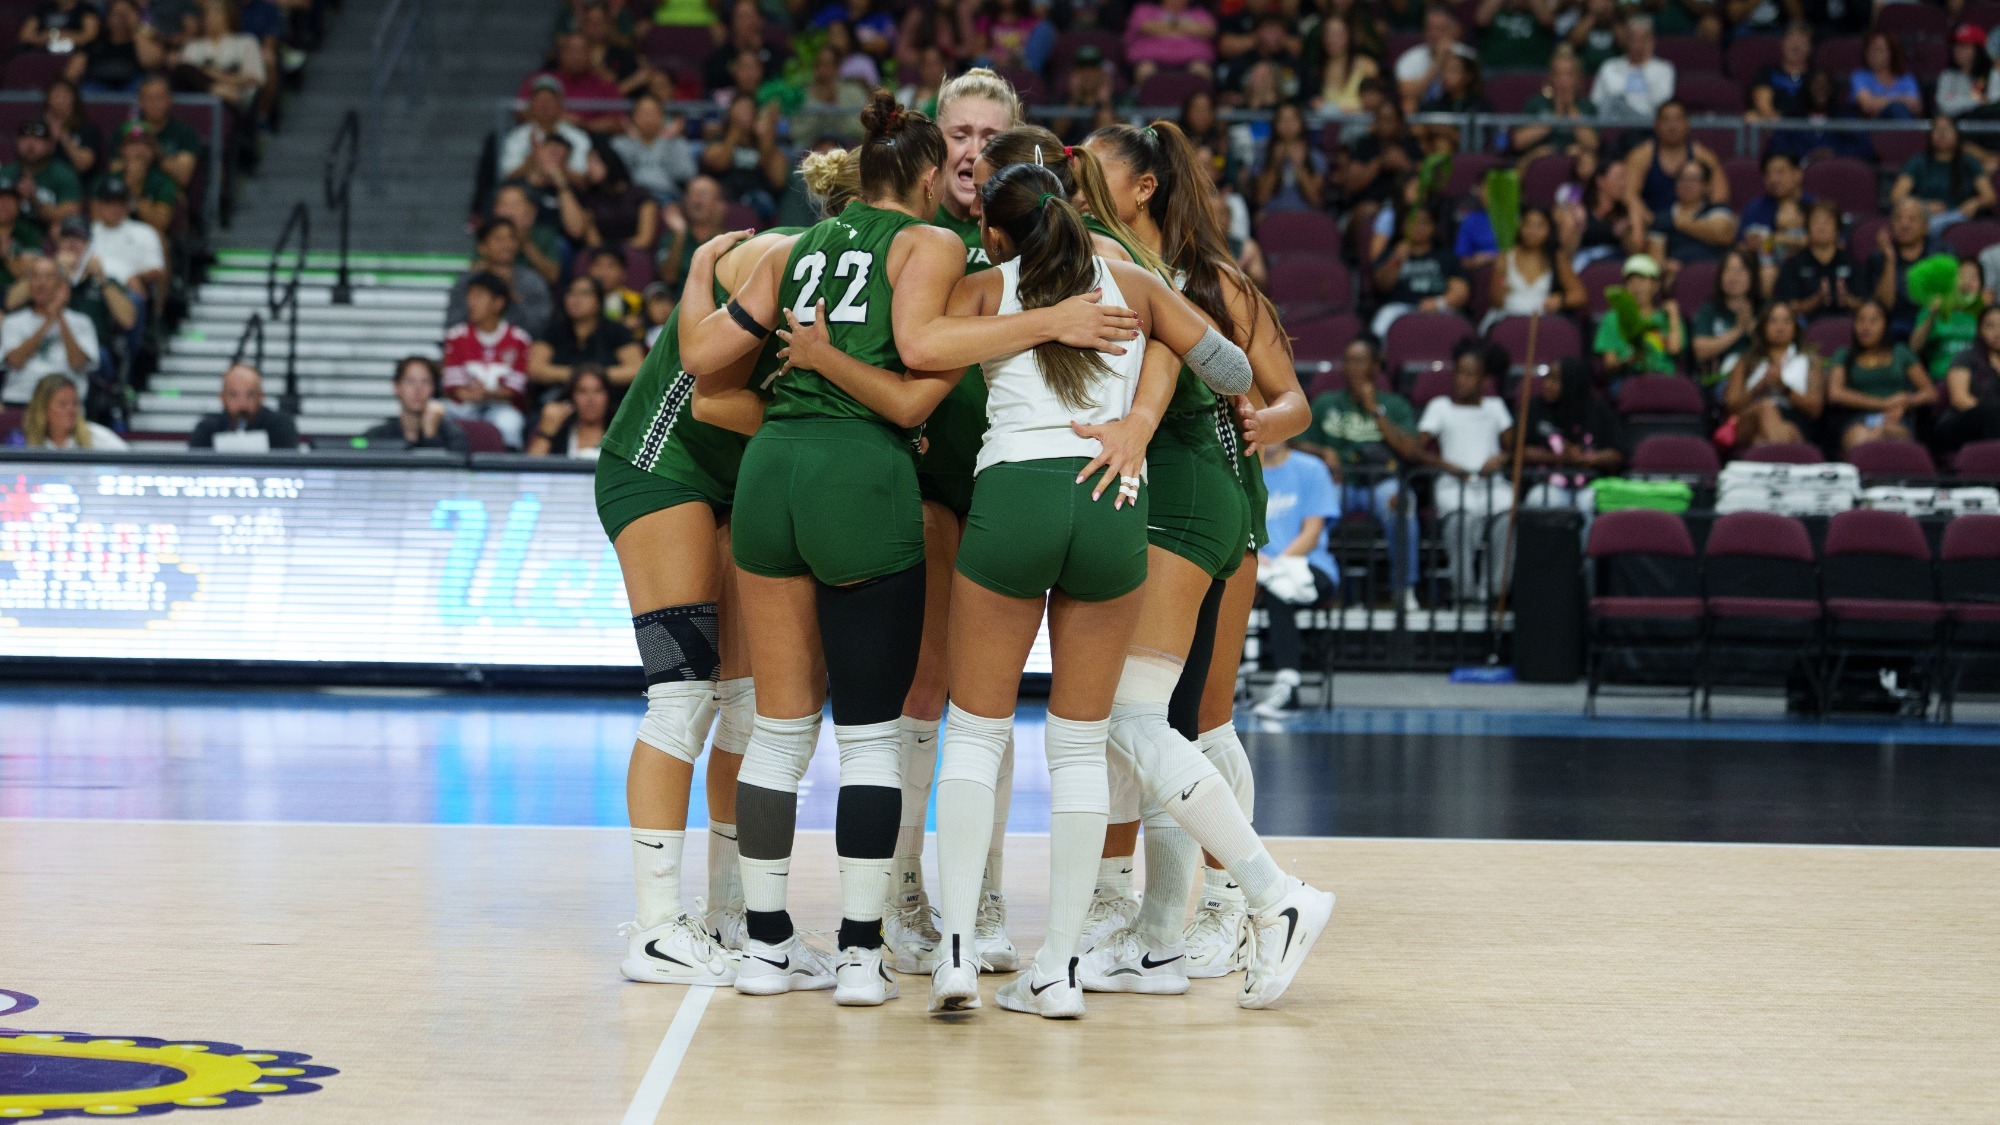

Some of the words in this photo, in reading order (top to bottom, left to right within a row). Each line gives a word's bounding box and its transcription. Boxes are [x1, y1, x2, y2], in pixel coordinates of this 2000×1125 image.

[791, 249, 873, 323] 22
[906, 894, 920, 903] NIKE
[1206, 900, 1222, 908] NIKE
